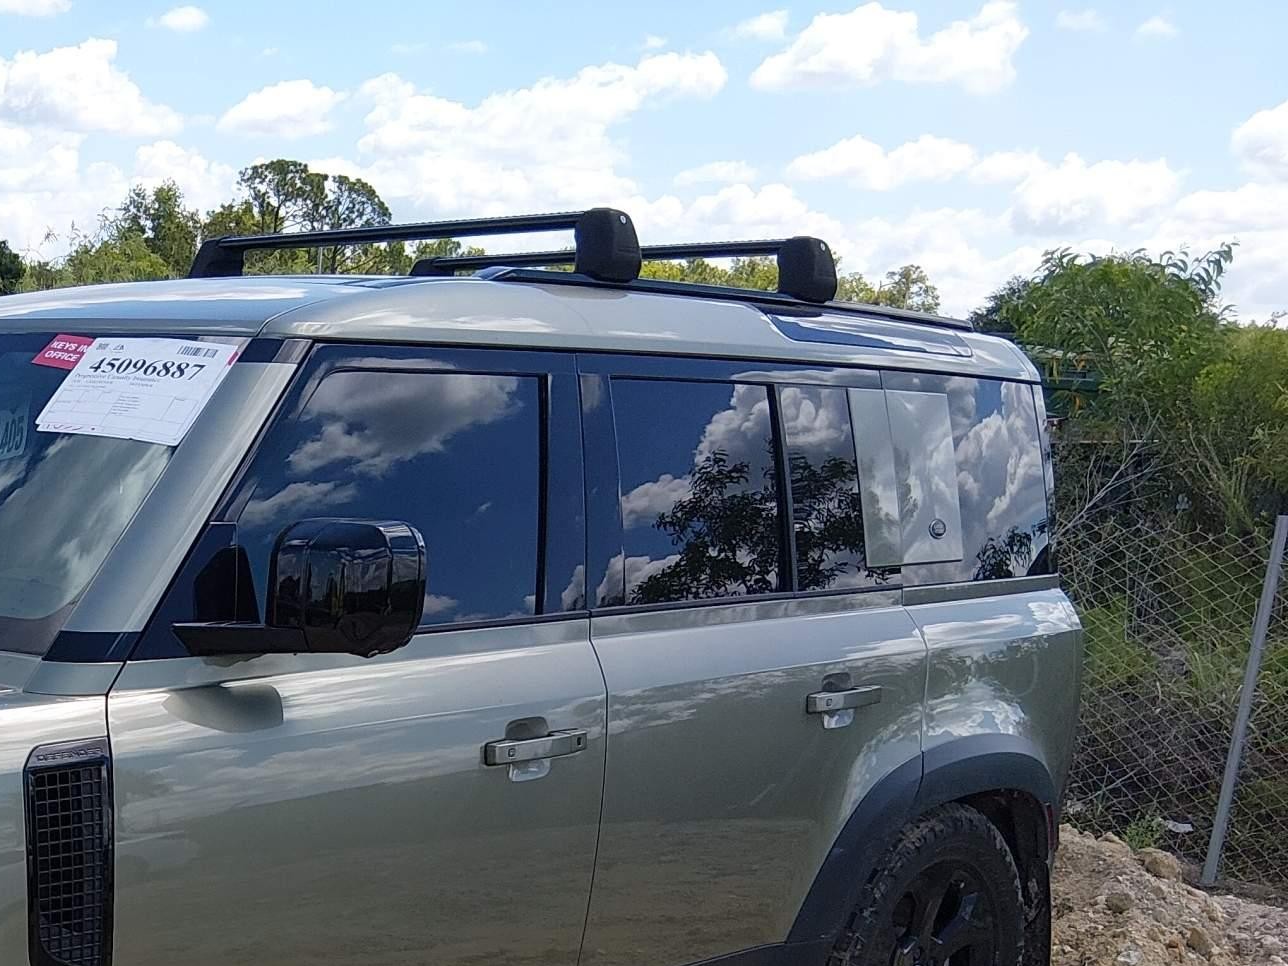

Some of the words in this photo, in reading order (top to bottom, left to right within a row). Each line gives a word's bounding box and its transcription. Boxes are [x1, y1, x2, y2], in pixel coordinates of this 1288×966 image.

[51, 341, 78, 351] KEYS
[77, 345, 88, 353] IN
[44, 350, 80, 362] OFFICE
[89, 356, 207, 381] 45096887
